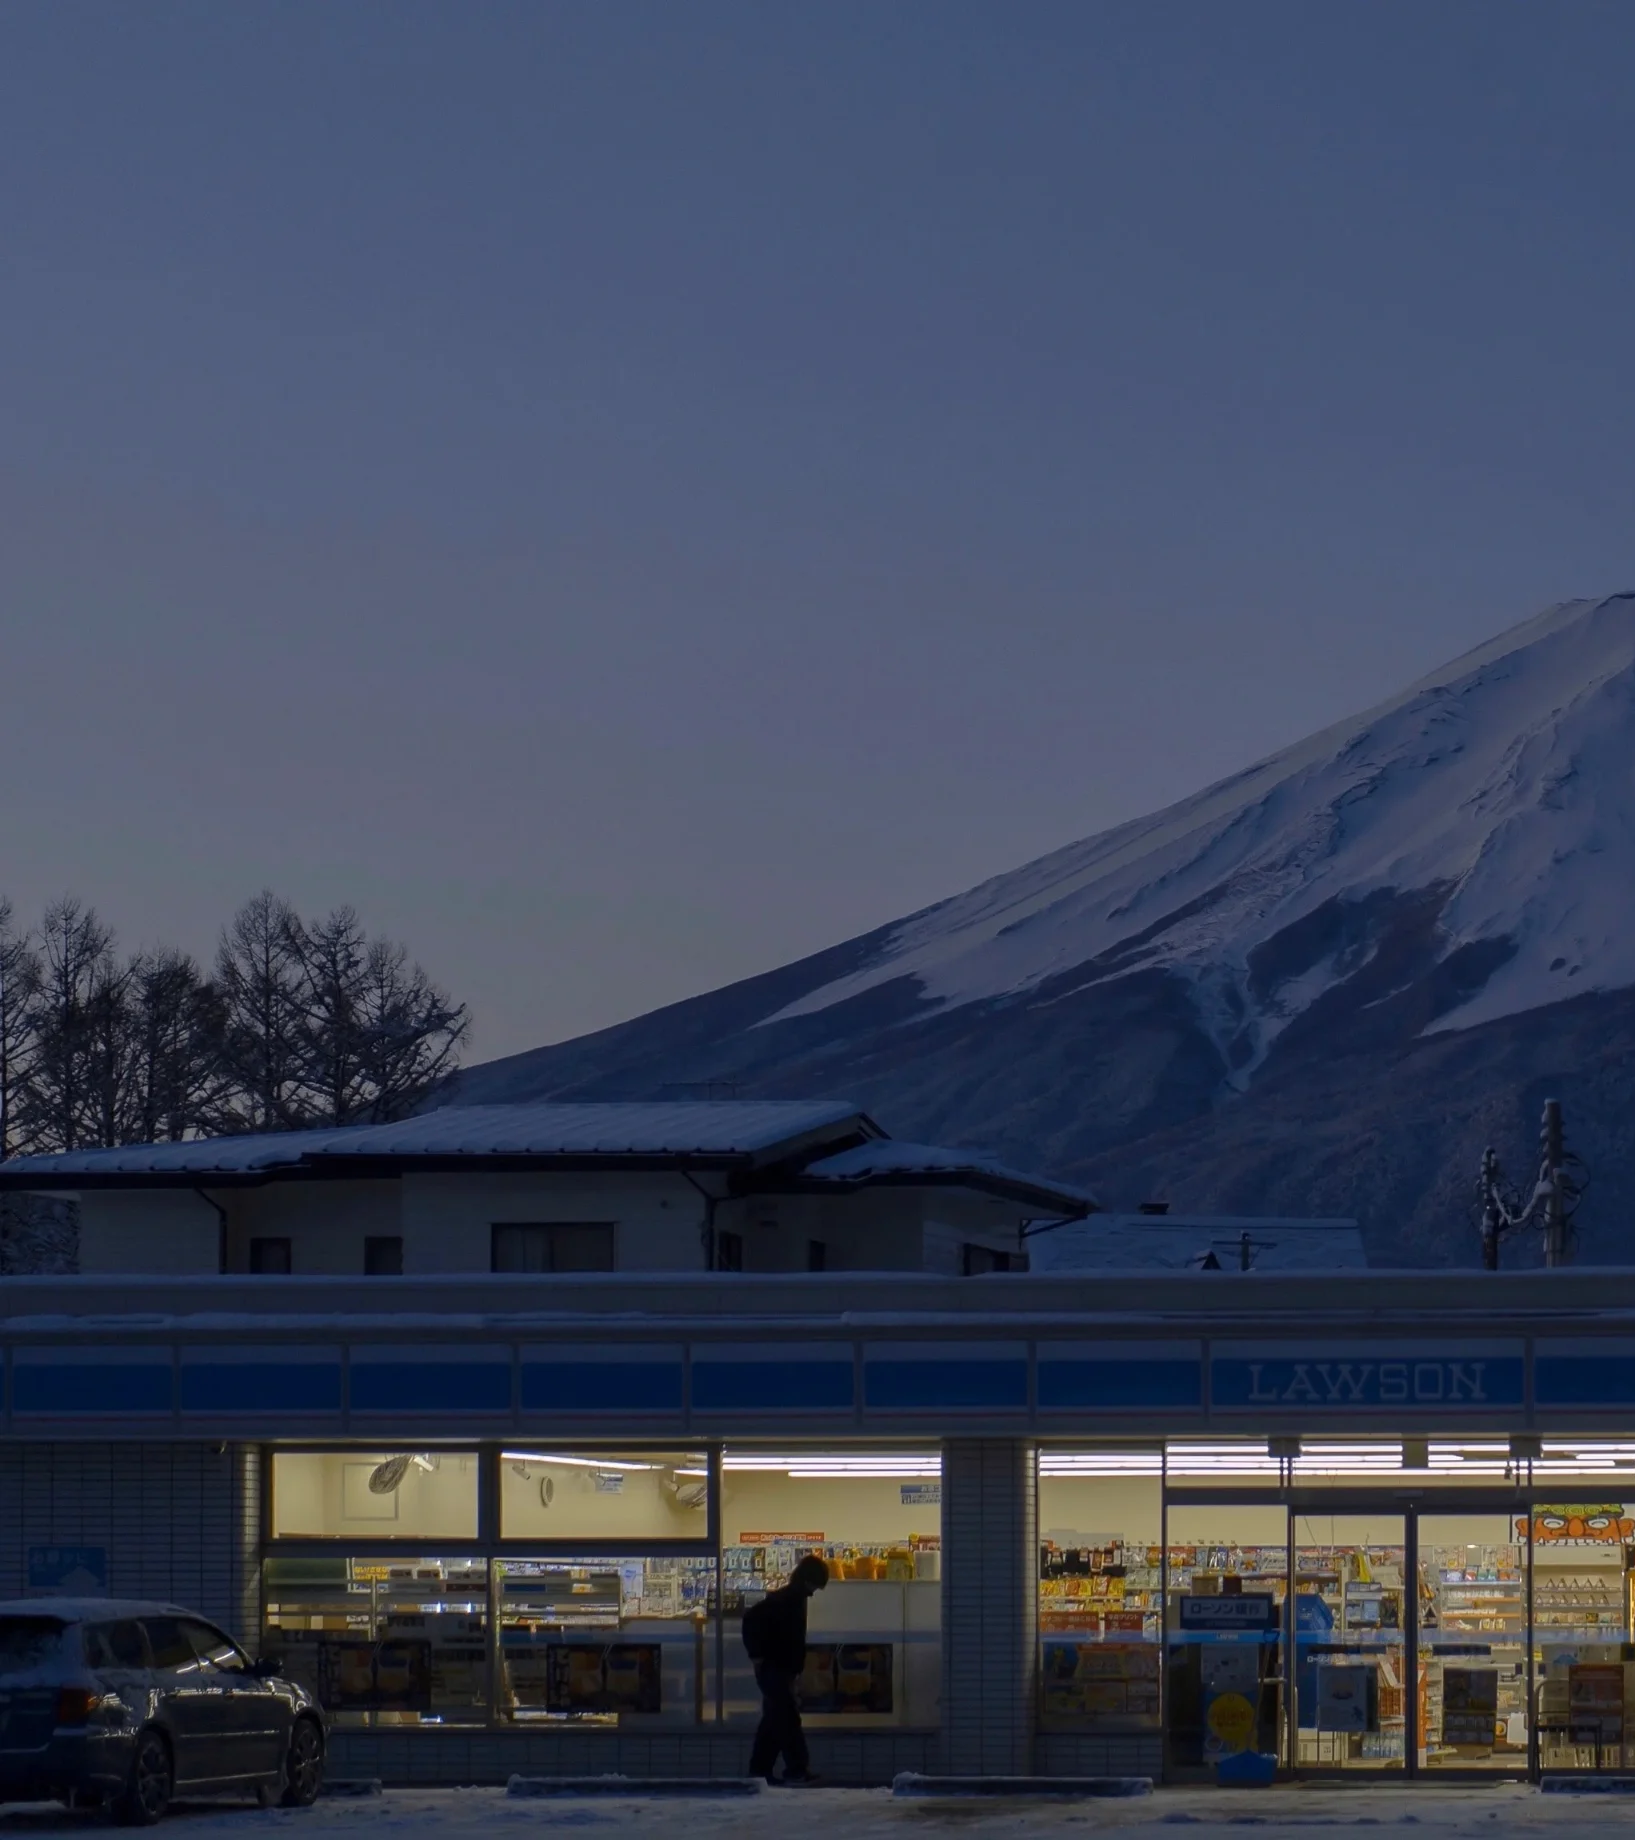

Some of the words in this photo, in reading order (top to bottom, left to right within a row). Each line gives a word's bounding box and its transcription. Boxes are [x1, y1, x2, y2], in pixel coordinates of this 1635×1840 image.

[1248, 1363, 1488, 1401] LAWSON
[1190, 1602, 1261, 1615] ローソン銀行
